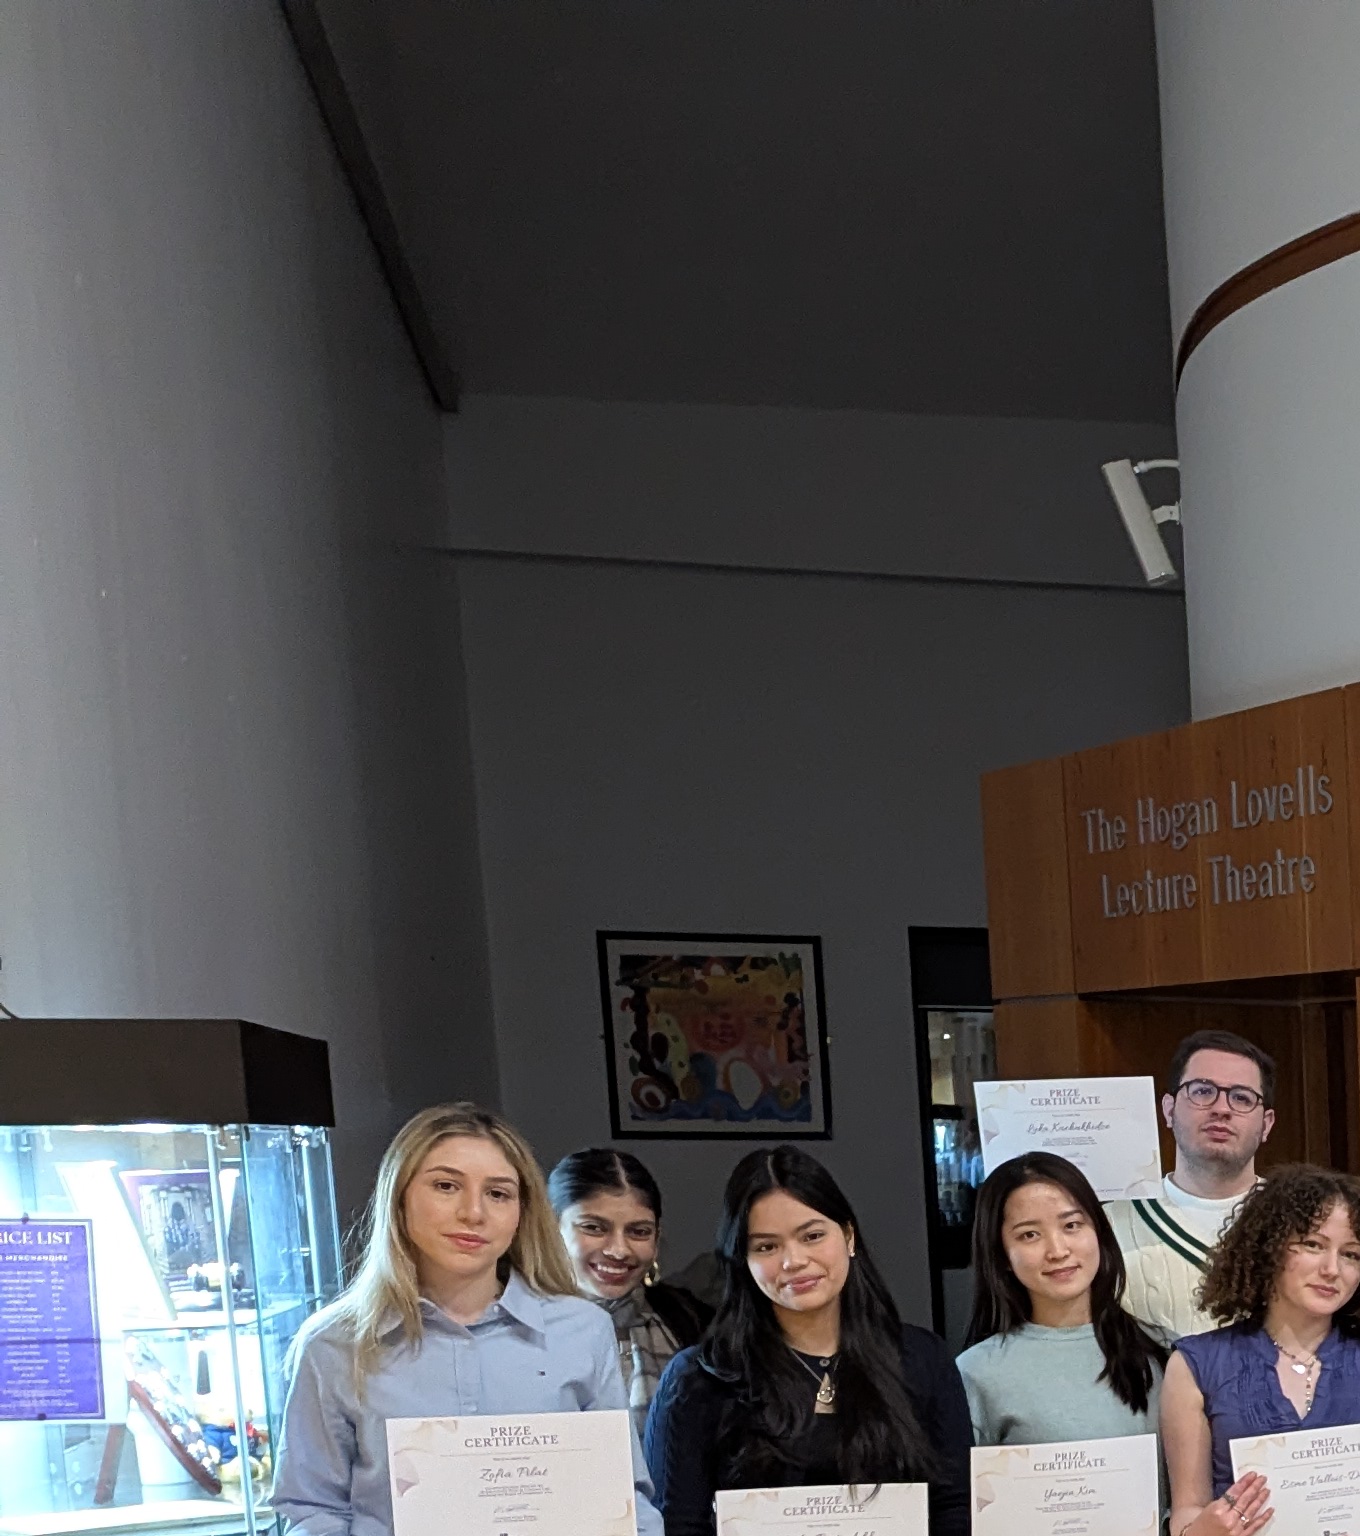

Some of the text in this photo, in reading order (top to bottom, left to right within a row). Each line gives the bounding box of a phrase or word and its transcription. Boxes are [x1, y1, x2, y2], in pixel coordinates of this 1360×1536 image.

[1080, 765, 1334, 854] The Hogan Lovells
[1102, 848, 1315, 918] Lecture Theatre
[1049, 1088, 1080, 1098] PRIZE
[1030, 1096, 1101, 1106] CERTIFICATE
[0, 1231, 73, 1245] ICE LIST
[490, 1425, 532, 1437] PRIZE
[464, 1435, 559, 1448] CERTIFICATE
[1311, 1436, 1343, 1449] PRIZE
[1055, 1451, 1086, 1461] PRIZE
[1033, 1458, 1106, 1471] CERTIFICATE
[806, 1496, 842, 1506] PRIZE
[783, 1504, 865, 1517] CERTIFICATE
